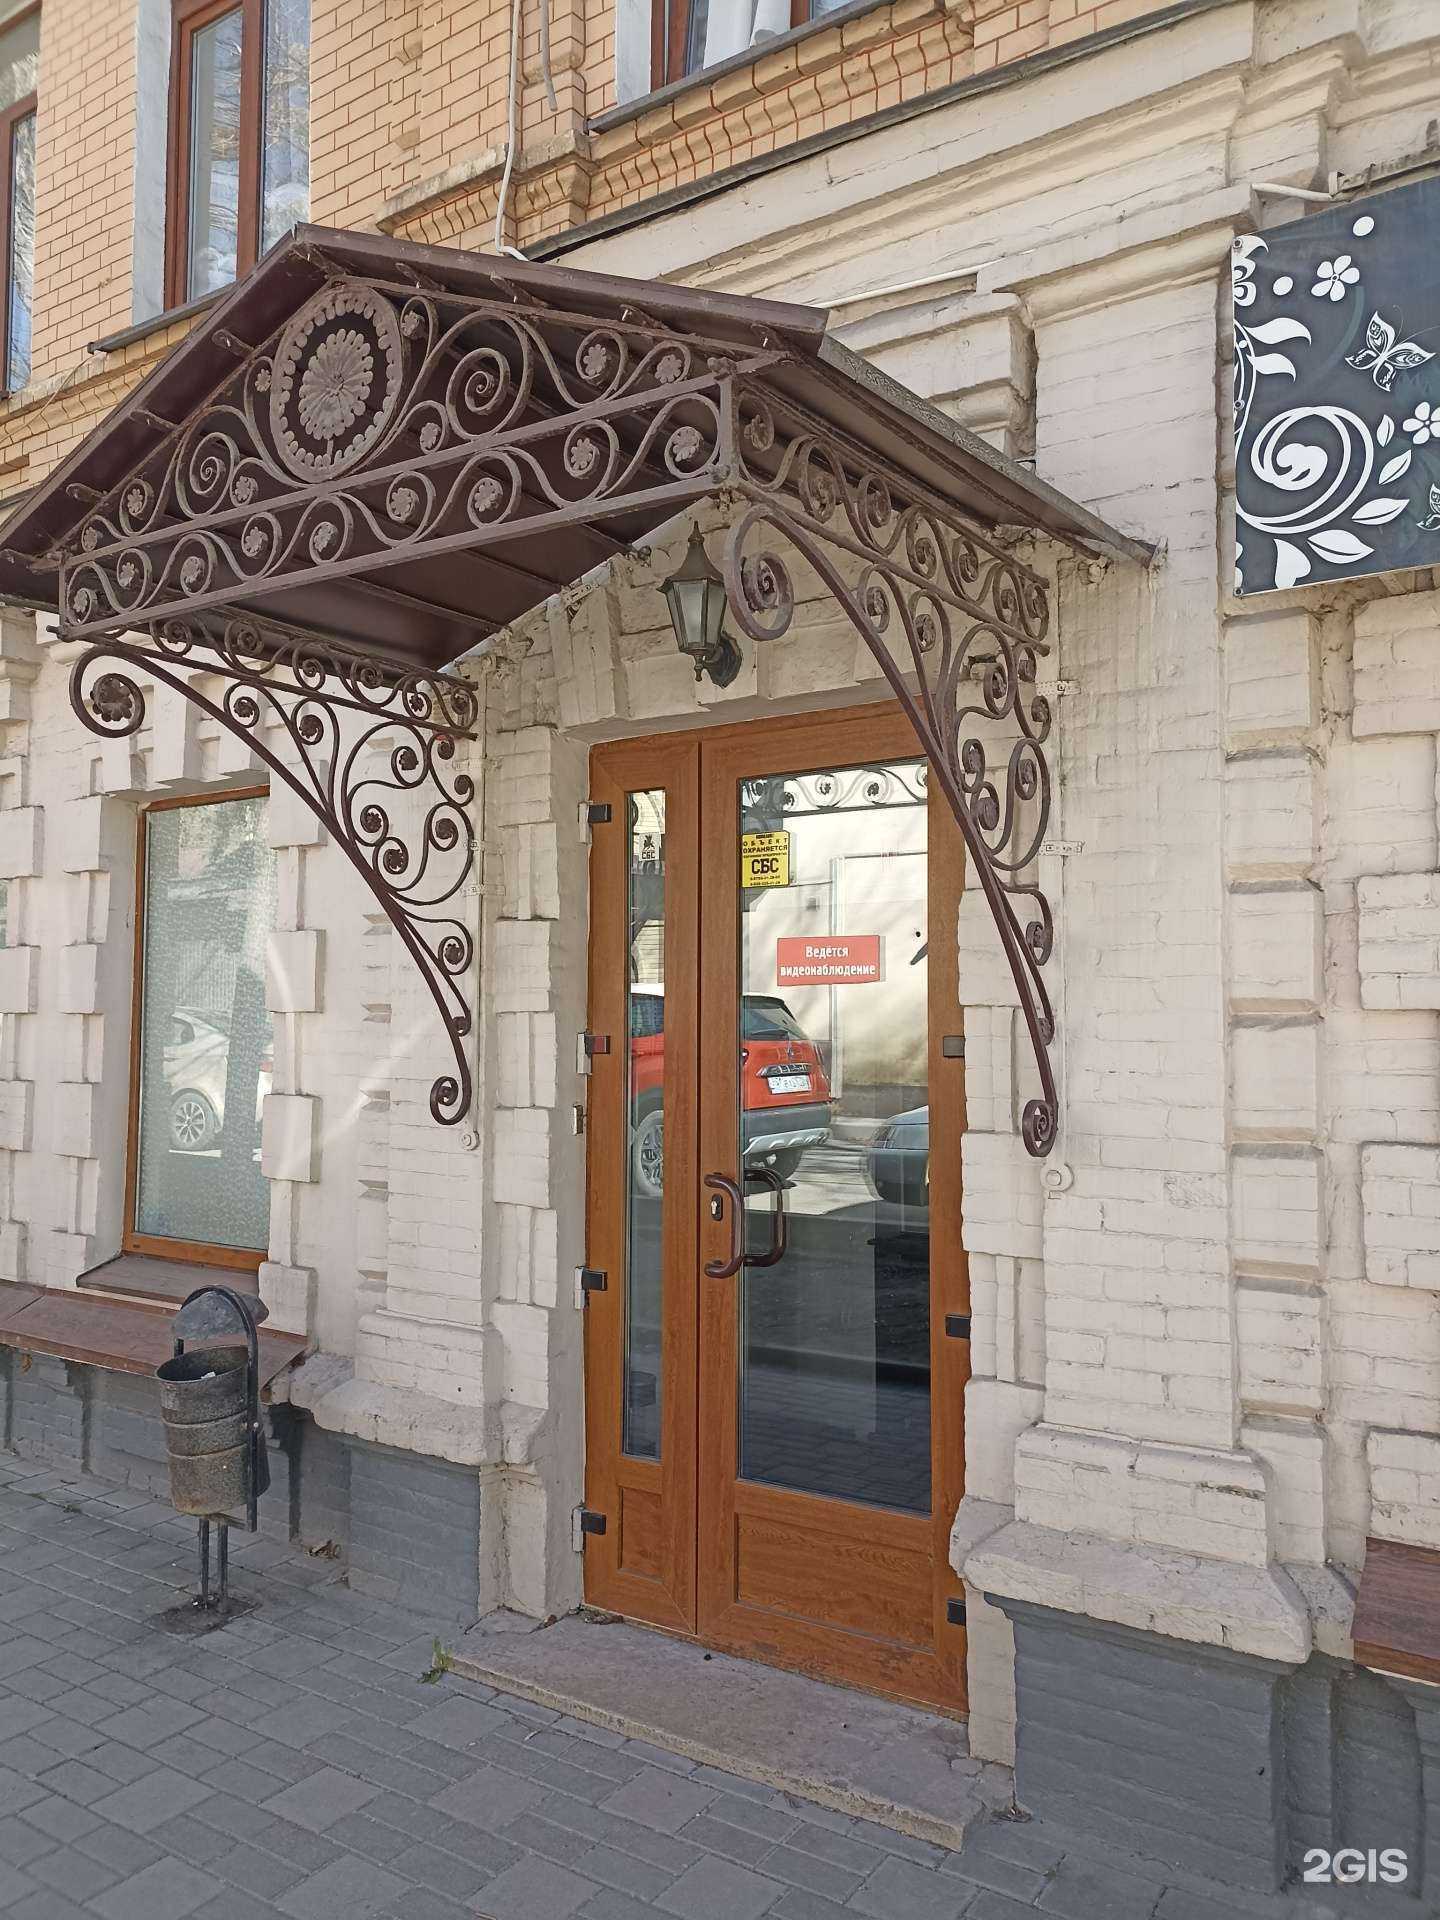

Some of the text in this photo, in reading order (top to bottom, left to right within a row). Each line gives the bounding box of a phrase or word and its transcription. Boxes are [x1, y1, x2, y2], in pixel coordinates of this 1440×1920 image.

[743, 845, 787, 853] ОХРАНЯЕТСЯ
[752, 858, 779, 874] СБС
[780, 964, 875, 977] видеонаблюдение
